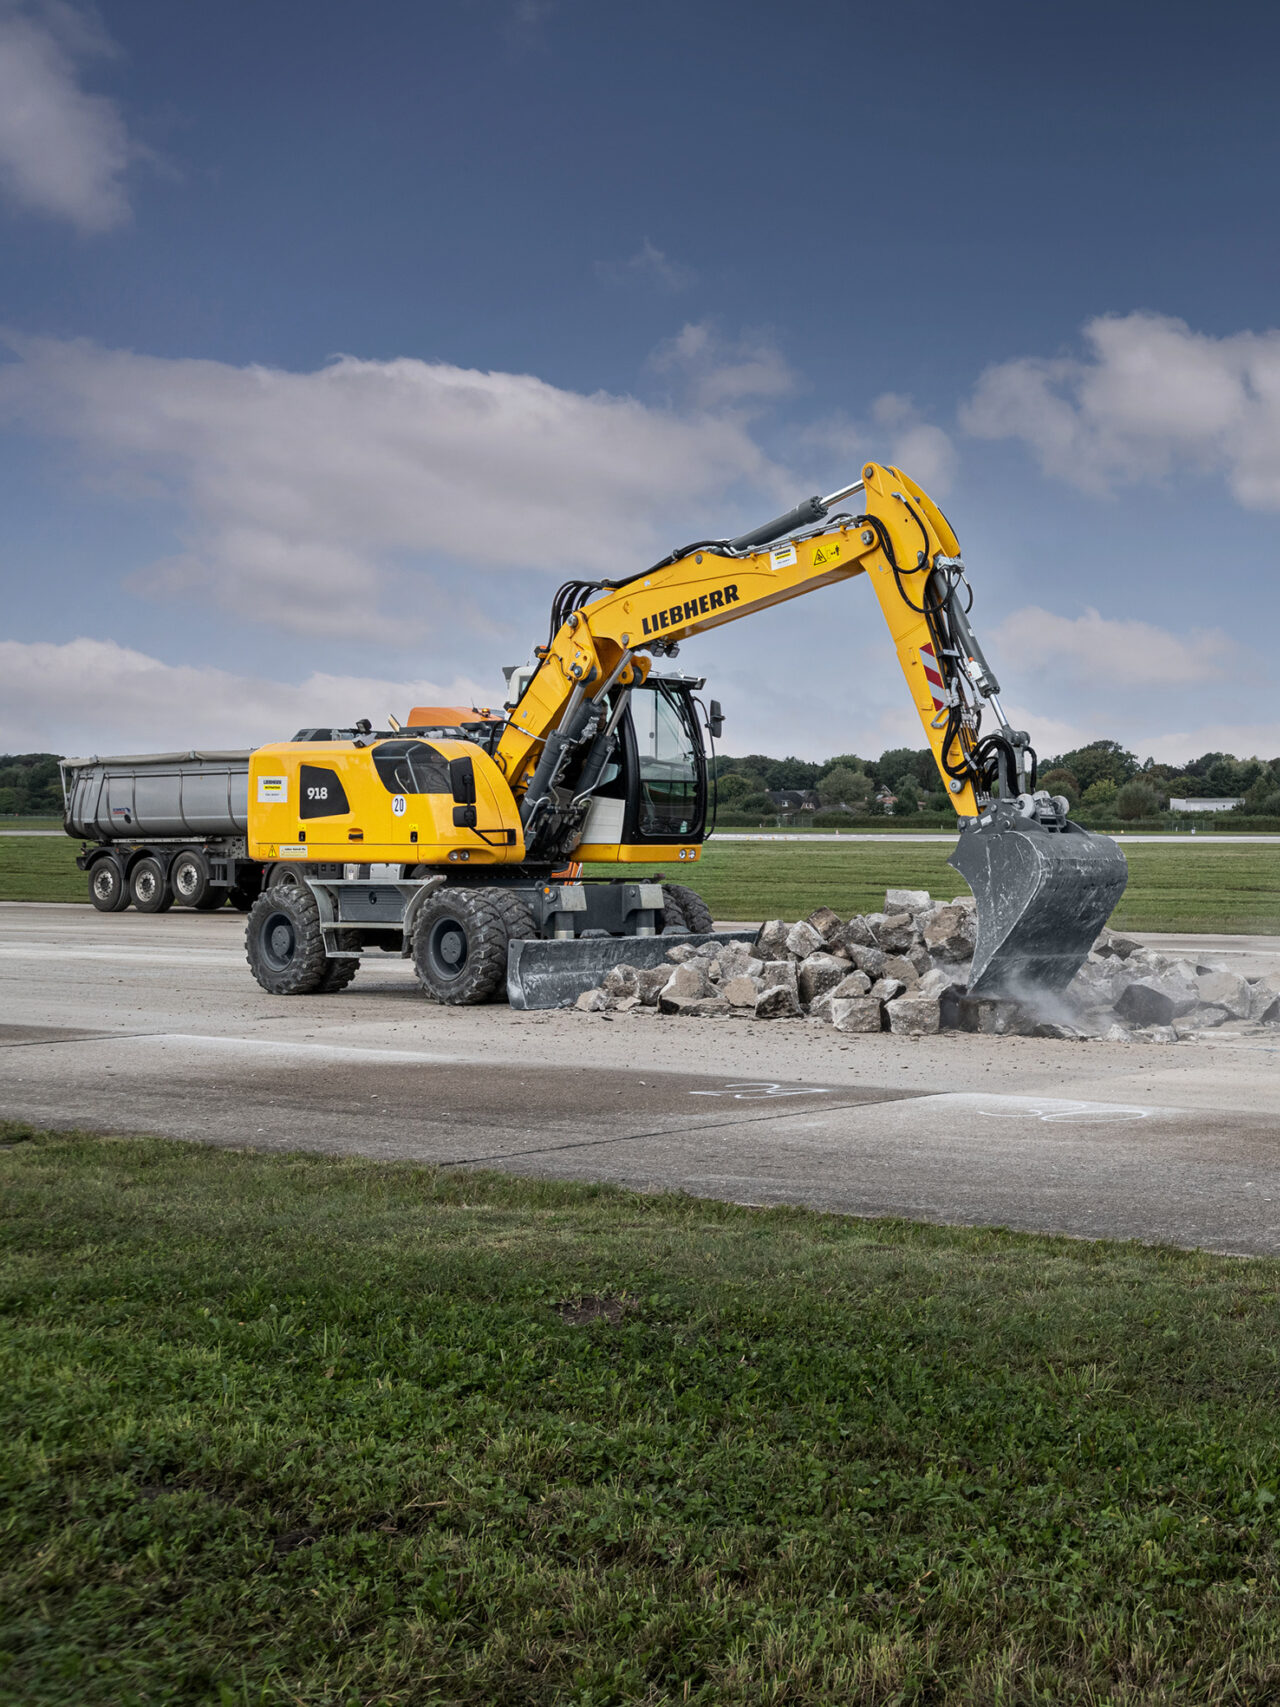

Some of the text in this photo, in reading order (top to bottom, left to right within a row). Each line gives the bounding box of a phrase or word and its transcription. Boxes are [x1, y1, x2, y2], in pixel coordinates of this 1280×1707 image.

[641, 584, 740, 635] LIEBHERR
[307, 787, 328, 800] 918
[394, 798, 404, 812] 20
